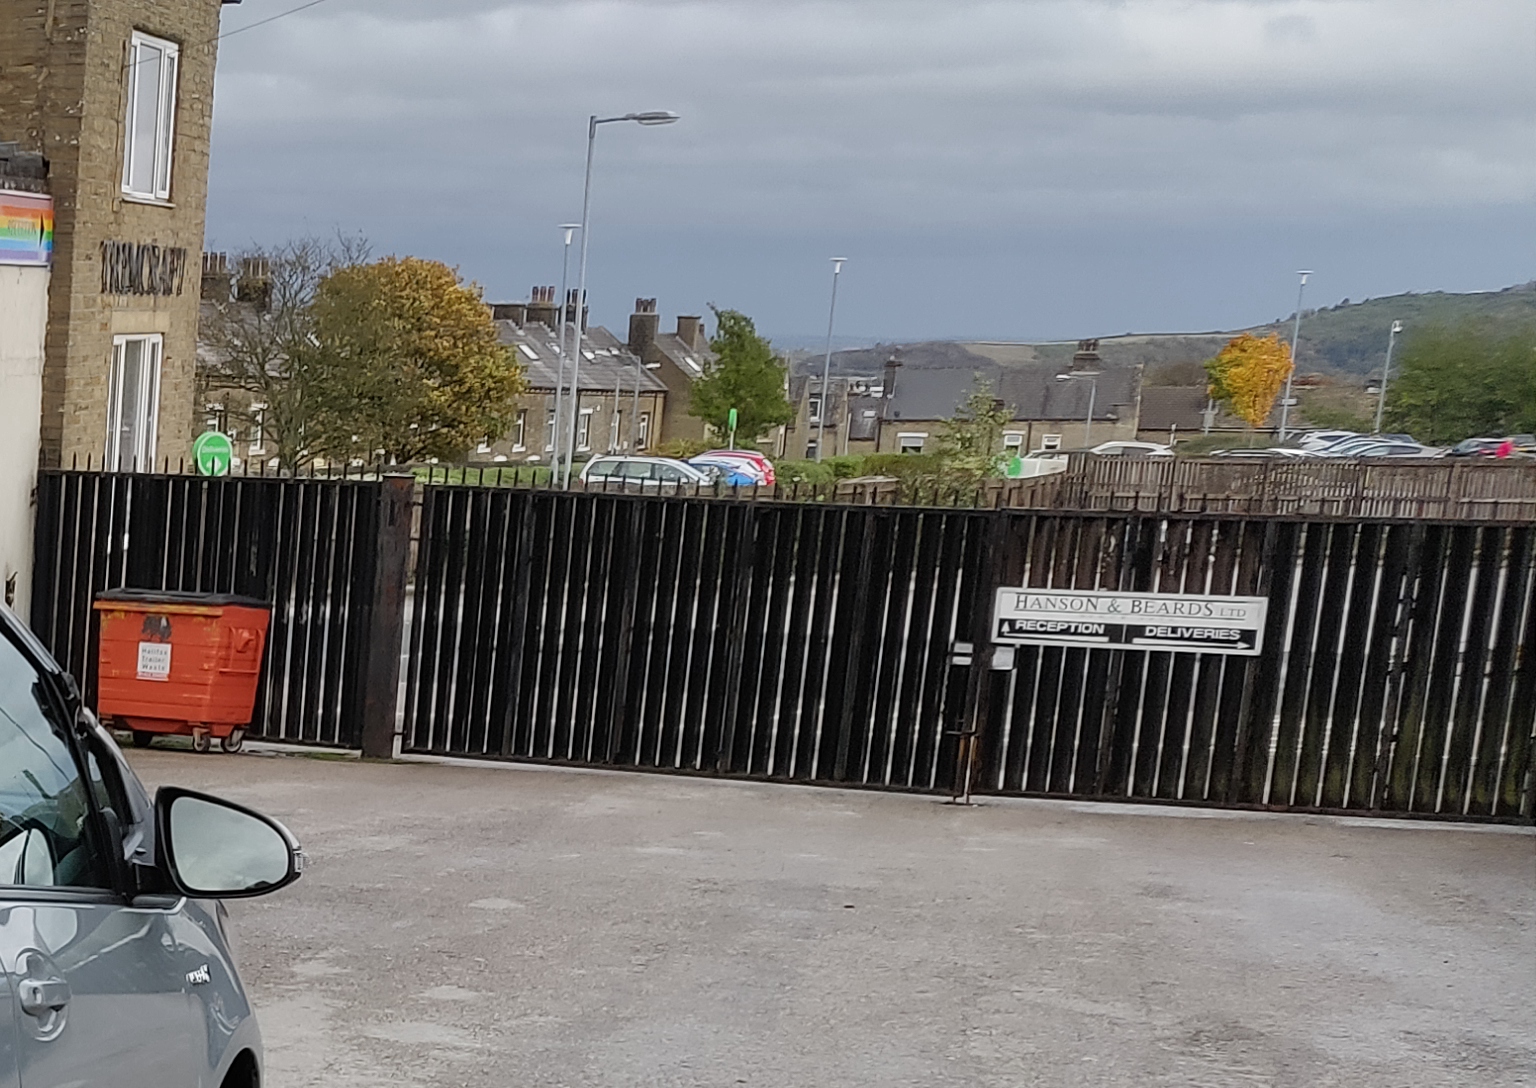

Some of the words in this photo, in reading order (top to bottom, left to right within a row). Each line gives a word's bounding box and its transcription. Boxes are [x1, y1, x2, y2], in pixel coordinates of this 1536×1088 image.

[1014, 595, 1100, 613] HANSON
[1107, 599, 1121, 613] &
[1130, 599, 1214, 616] BEARDS
[1219, 607, 1246, 618] LTD
[1015, 620, 1105, 634] RECEPTION
[1144, 626, 1241, 641] DELIVERIES
